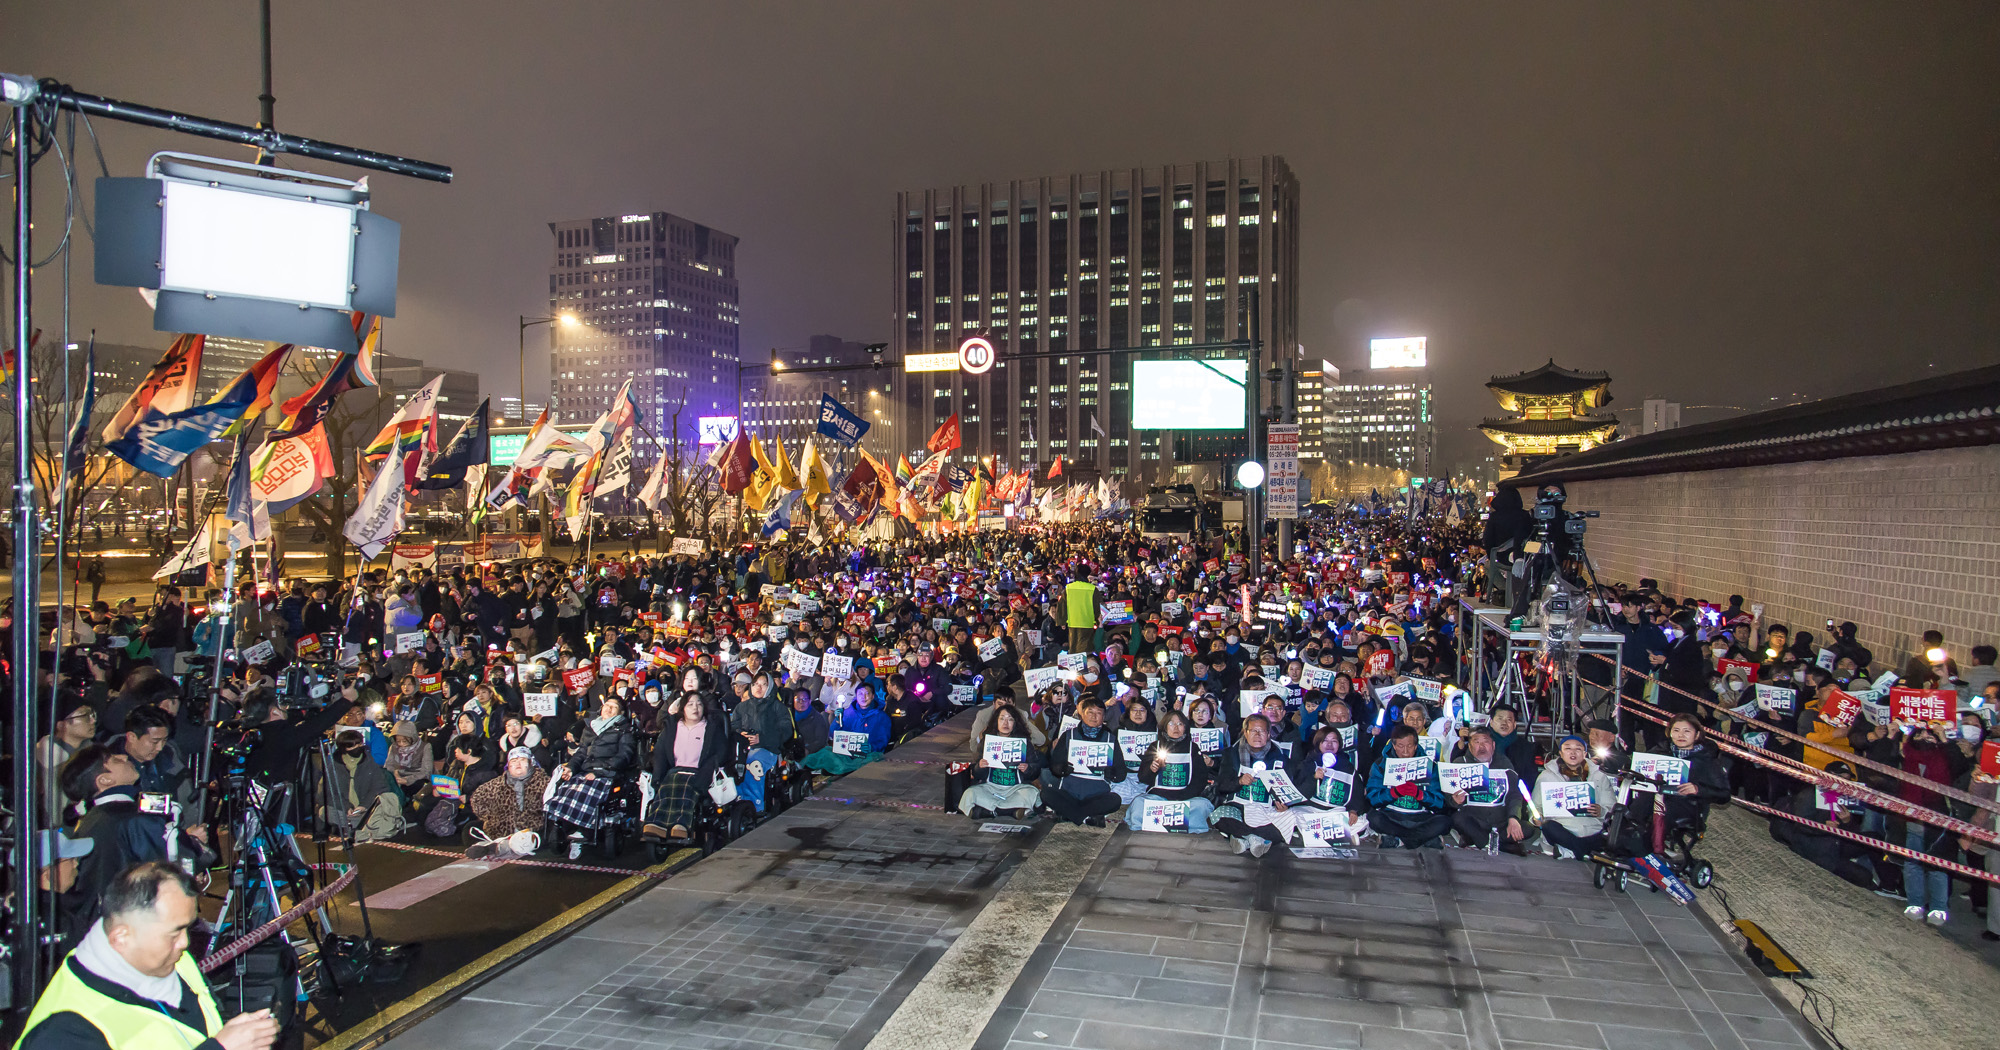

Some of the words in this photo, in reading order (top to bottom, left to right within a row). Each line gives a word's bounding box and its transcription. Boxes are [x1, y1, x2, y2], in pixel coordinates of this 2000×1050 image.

[967, 347, 987, 364] 40
[822, 408, 859, 439] 강서(을)
[1313, 671, 1332, 681] 즉각
[1312, 678, 1330, 689] 파면
[1771, 689, 1791, 701] 즉각
[1771, 698, 1791, 709] 파면
[1837, 699, 1861, 715] 윤석
[1899, 695, 1946, 709] 새봄에는
[1898, 707, 1946, 720] 새나라로
[1136, 733, 1157, 746] 해체
[1200, 730, 1220, 743] 즉각
[1002, 740, 1023, 753] 즉각
[1088, 744, 1109, 757] 즉각
[1135, 745, 1149, 756] 하
[1200, 740, 1220, 753] 파면
[1001, 751, 1023, 763] 파면
[1087, 755, 1108, 767] 파면
[1406, 757, 1428, 772] 즉각
[1656, 759, 1682, 774] 즉각
[1406, 769, 1427, 782] 파면
[1459, 764, 1483, 779] 해체
[1459, 776, 1484, 790] 하라
[1564, 783, 1590, 799] 즉각
[1565, 795, 1591, 810] 파면
[1163, 803, 1185, 817] 즉각
[1162, 814, 1184, 826] 파면
[1323, 826, 1346, 840] 파면
